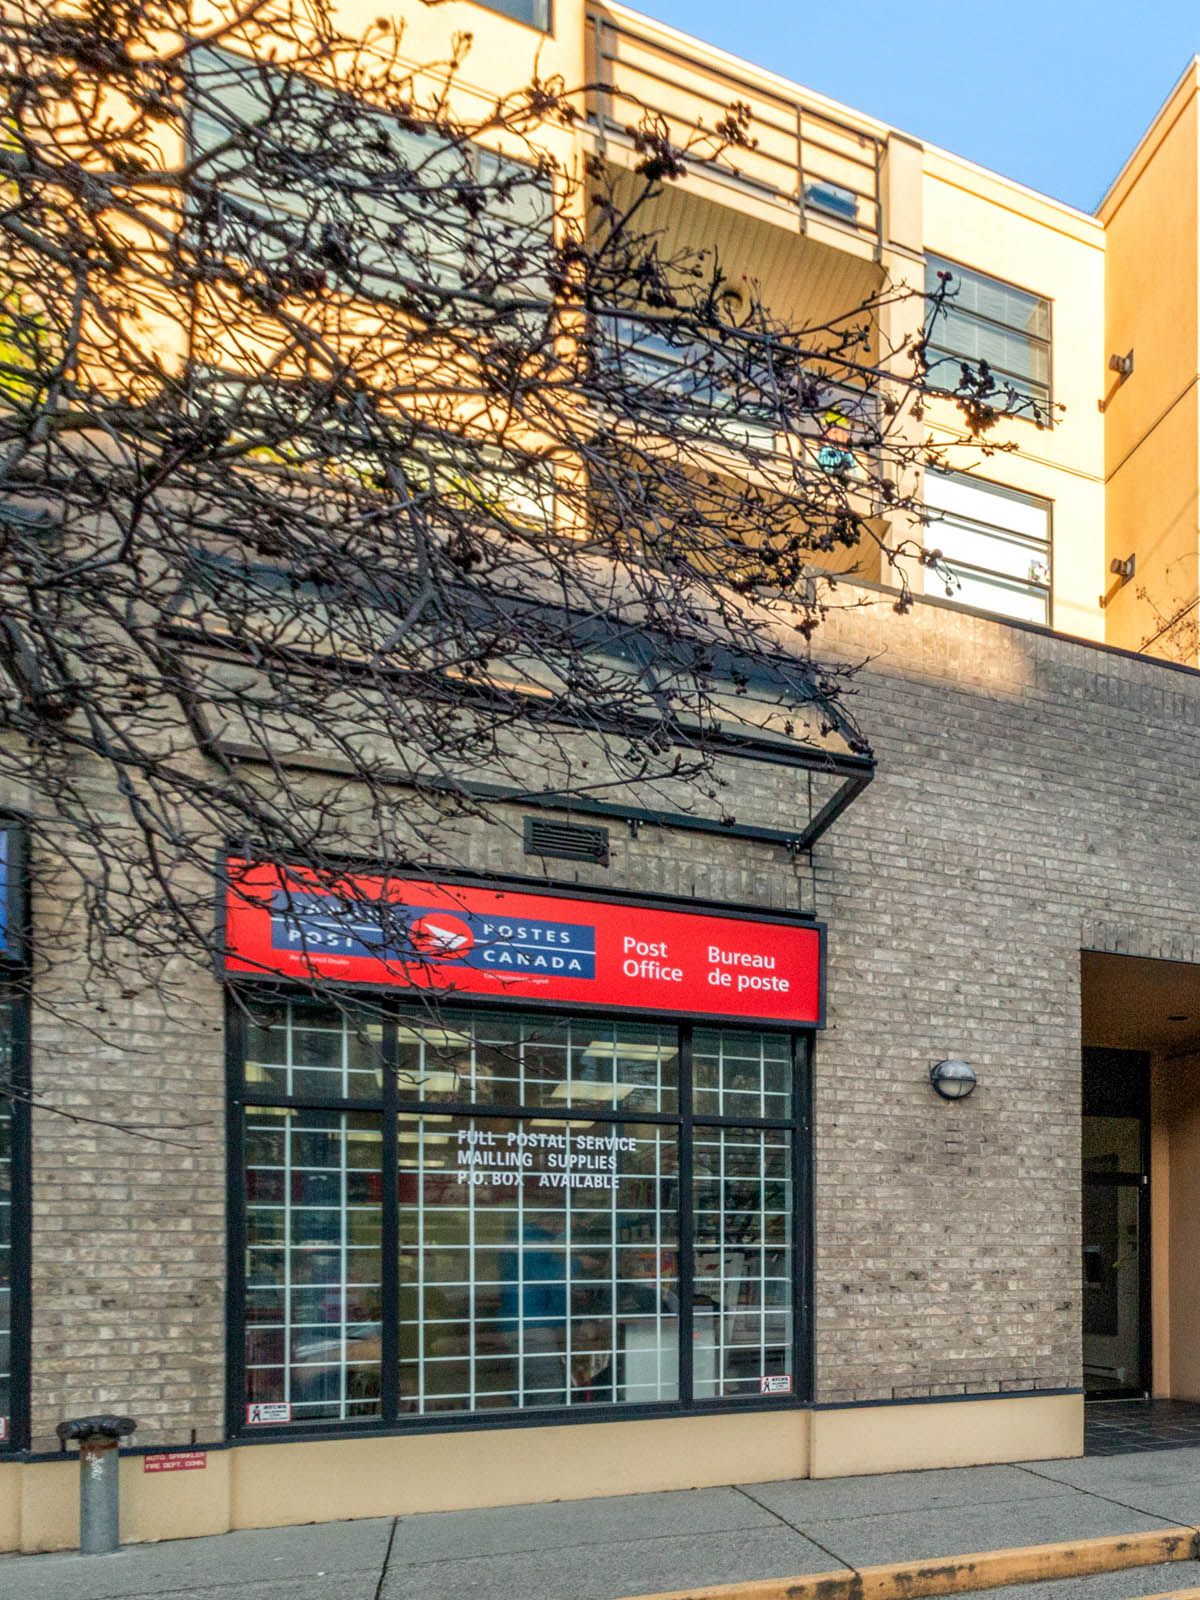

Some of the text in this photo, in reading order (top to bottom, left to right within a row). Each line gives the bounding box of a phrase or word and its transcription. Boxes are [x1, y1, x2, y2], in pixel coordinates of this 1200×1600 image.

[483, 923, 571, 944] POSTES
[623, 936, 668, 959] Post
[707, 945, 776, 970] Bureau
[483, 950, 583, 971] CANADA
[623, 959, 684, 982] Office
[707, 968, 790, 993] de poste
[458, 1130, 637, 1152] FULL POSTAL SERVICE
[457, 1150, 618, 1170] MAILLING SUPPLIES
[492, 1173, 524, 1186] BOX
[538, 1174, 620, 1190] AVAILABLE
